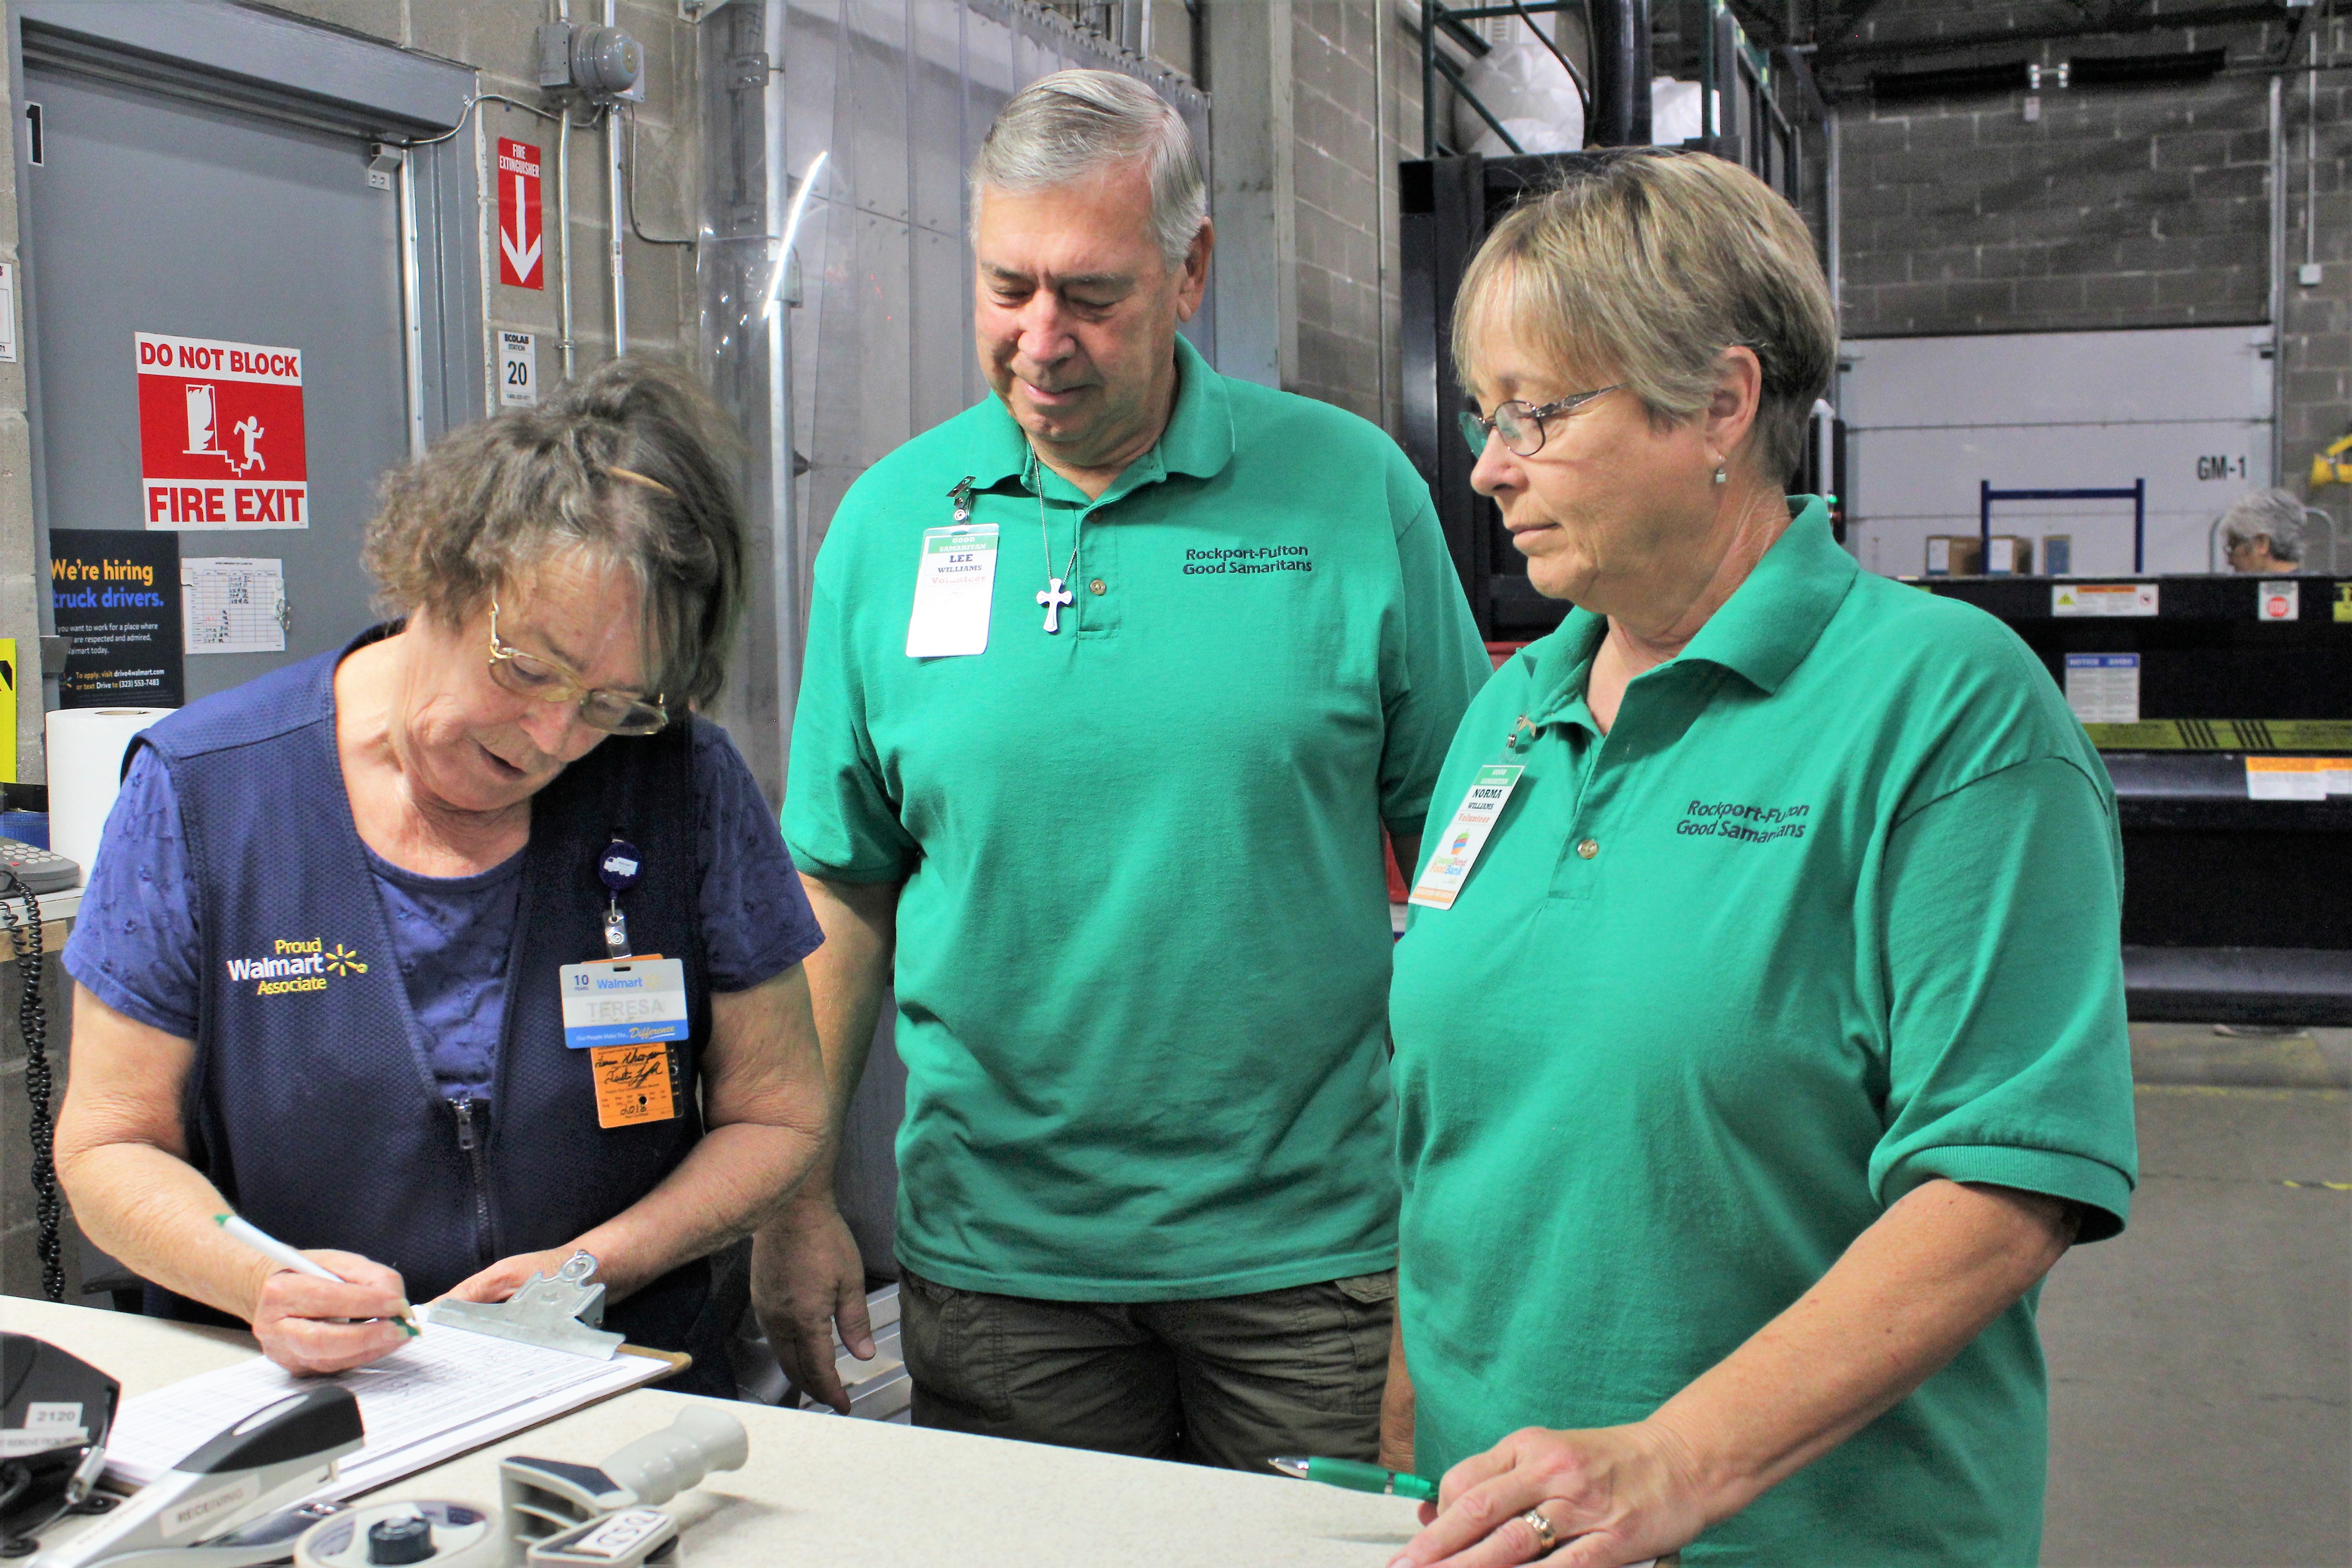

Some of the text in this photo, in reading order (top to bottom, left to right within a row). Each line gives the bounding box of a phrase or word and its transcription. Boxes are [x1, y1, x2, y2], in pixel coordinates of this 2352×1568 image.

[26, 104, 42, 164] 1
[512, 143, 525, 159] FIRE
[500, 155, 540, 178] EXTINGUISHER
[505, 333, 529, 344] ECOLAB
[140, 342, 299, 377] DO NOT BLOCK
[508, 361, 527, 385] 20
[2197, 455, 2247, 480] GM-1
[149, 487, 304, 522] FIRE EXIT
[939, 544, 986, 552] SAMARITAN
[1186, 546, 1308, 561] Rockport-Fulton
[950, 554, 973, 563] LEE
[51, 559, 153, 586] We're hiring
[938, 565, 982, 573] WILLIAMS
[1183, 560, 1312, 574] Good Samaritans
[54, 587, 164, 608] truck drivers.
[124, 622, 139, 632] place
[85, 635, 114, 644] respected
[114, 669, 165, 677] drive4walmart.com
[119, 680, 133, 689] (323)
[134, 678, 160, 687] 553-7483
[1472, 789, 1503, 799] NORMA
[1458, 813, 1491, 823] Volunteer
[1687, 800, 1810, 823] Rockport-Fuon
[1677, 820, 1806, 843] Good Samarans
[274, 937, 323, 955] Proud
[226, 952, 324, 981] Walmart
[256, 976, 327, 995] Associate
[574, 975, 642, 989] 10 Walmart
[588, 998, 665, 1018] TERESA
[629, 1026, 675, 1039] Difference
[37, 1410, 76, 1422] 2120
